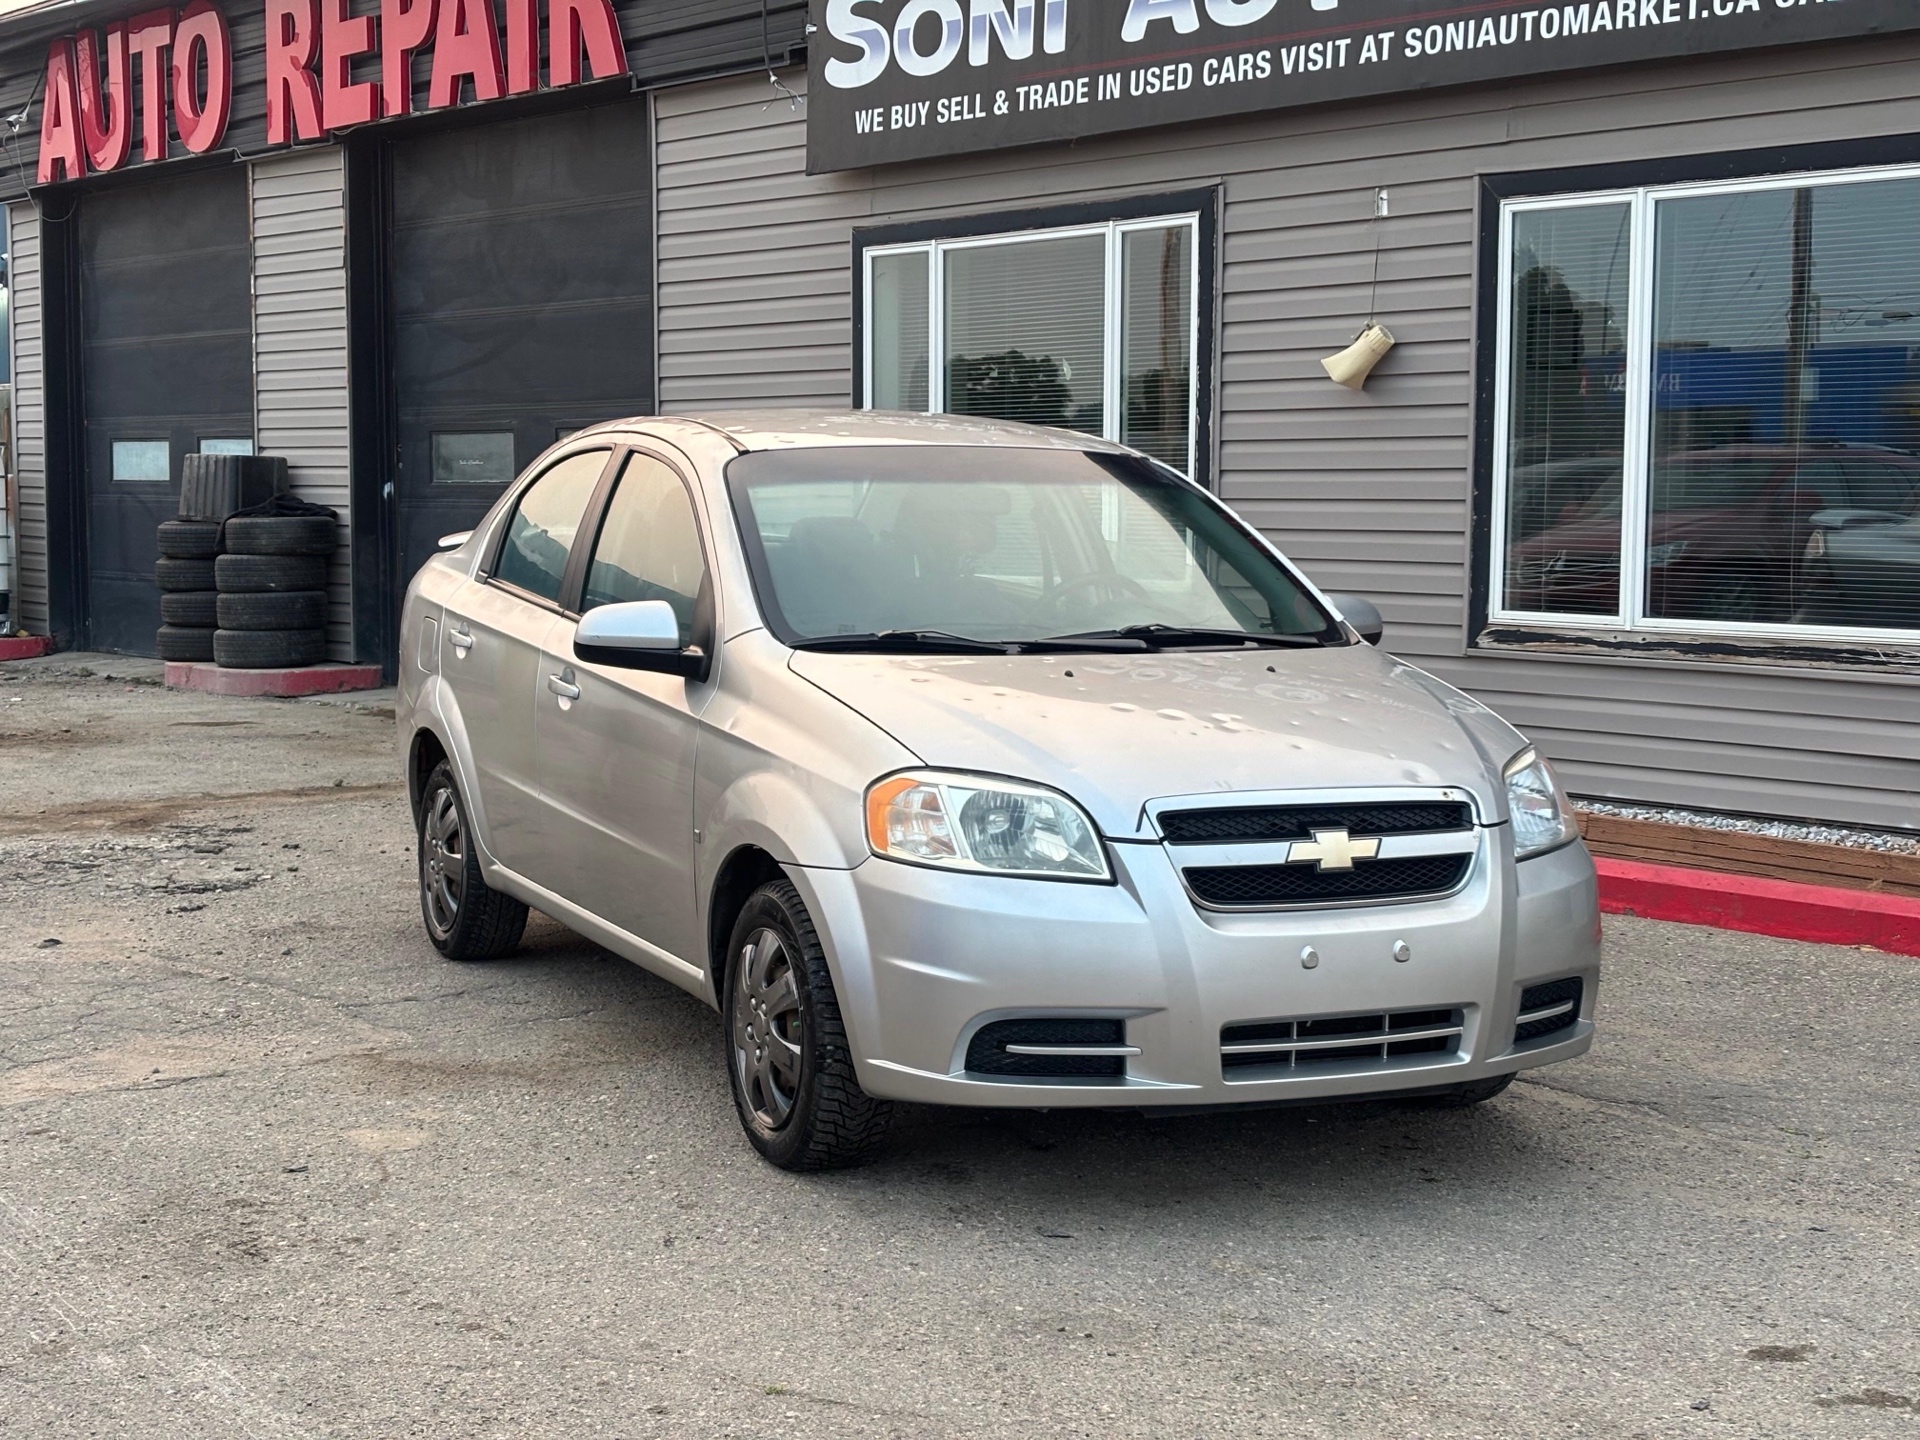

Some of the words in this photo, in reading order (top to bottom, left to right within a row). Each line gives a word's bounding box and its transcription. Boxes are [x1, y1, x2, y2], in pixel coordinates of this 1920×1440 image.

[37, 0, 233, 184] AUTO
[824, 0, 1068, 89] SONI
[855, 108, 884, 134] WE
[890, 101, 930, 130] BUY
[936, 93, 986, 124] SELL
[993, 90, 1010, 116] &
[1016, 77, 1089, 112] TRADE
[1097, 72, 1121, 101] IN
[1130, 62, 1193, 97] USED
[1202, 50, 1272, 87] CARS
[1280, 38, 1351, 75] VISIT
[1358, 31, 1395, 64] AT
